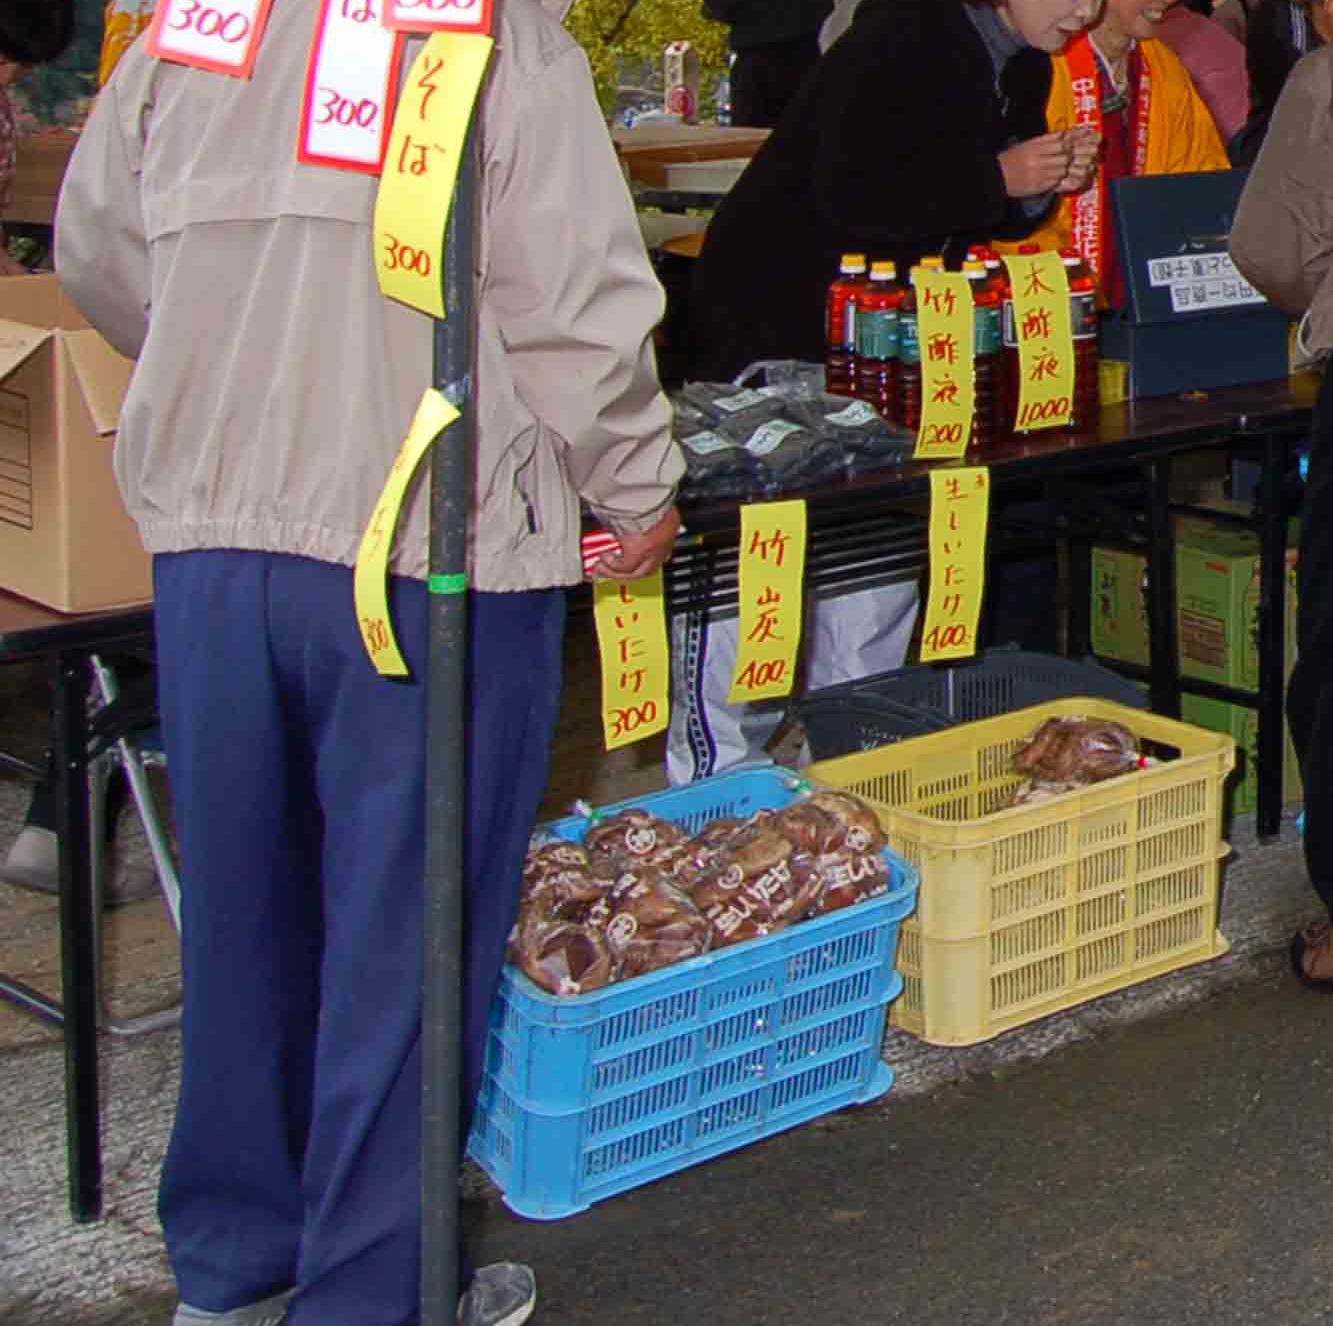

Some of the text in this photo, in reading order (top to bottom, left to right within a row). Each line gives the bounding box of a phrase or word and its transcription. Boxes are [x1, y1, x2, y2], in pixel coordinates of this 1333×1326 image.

[315, 87, 377, 128] 300
[398, 55, 445, 176] そば
[383, 233, 431, 278] 300
[747, 529, 791, 642] 竹炭
[944, 477, 968, 616] 生しいたけ
[608, 701, 657, 739] 300
